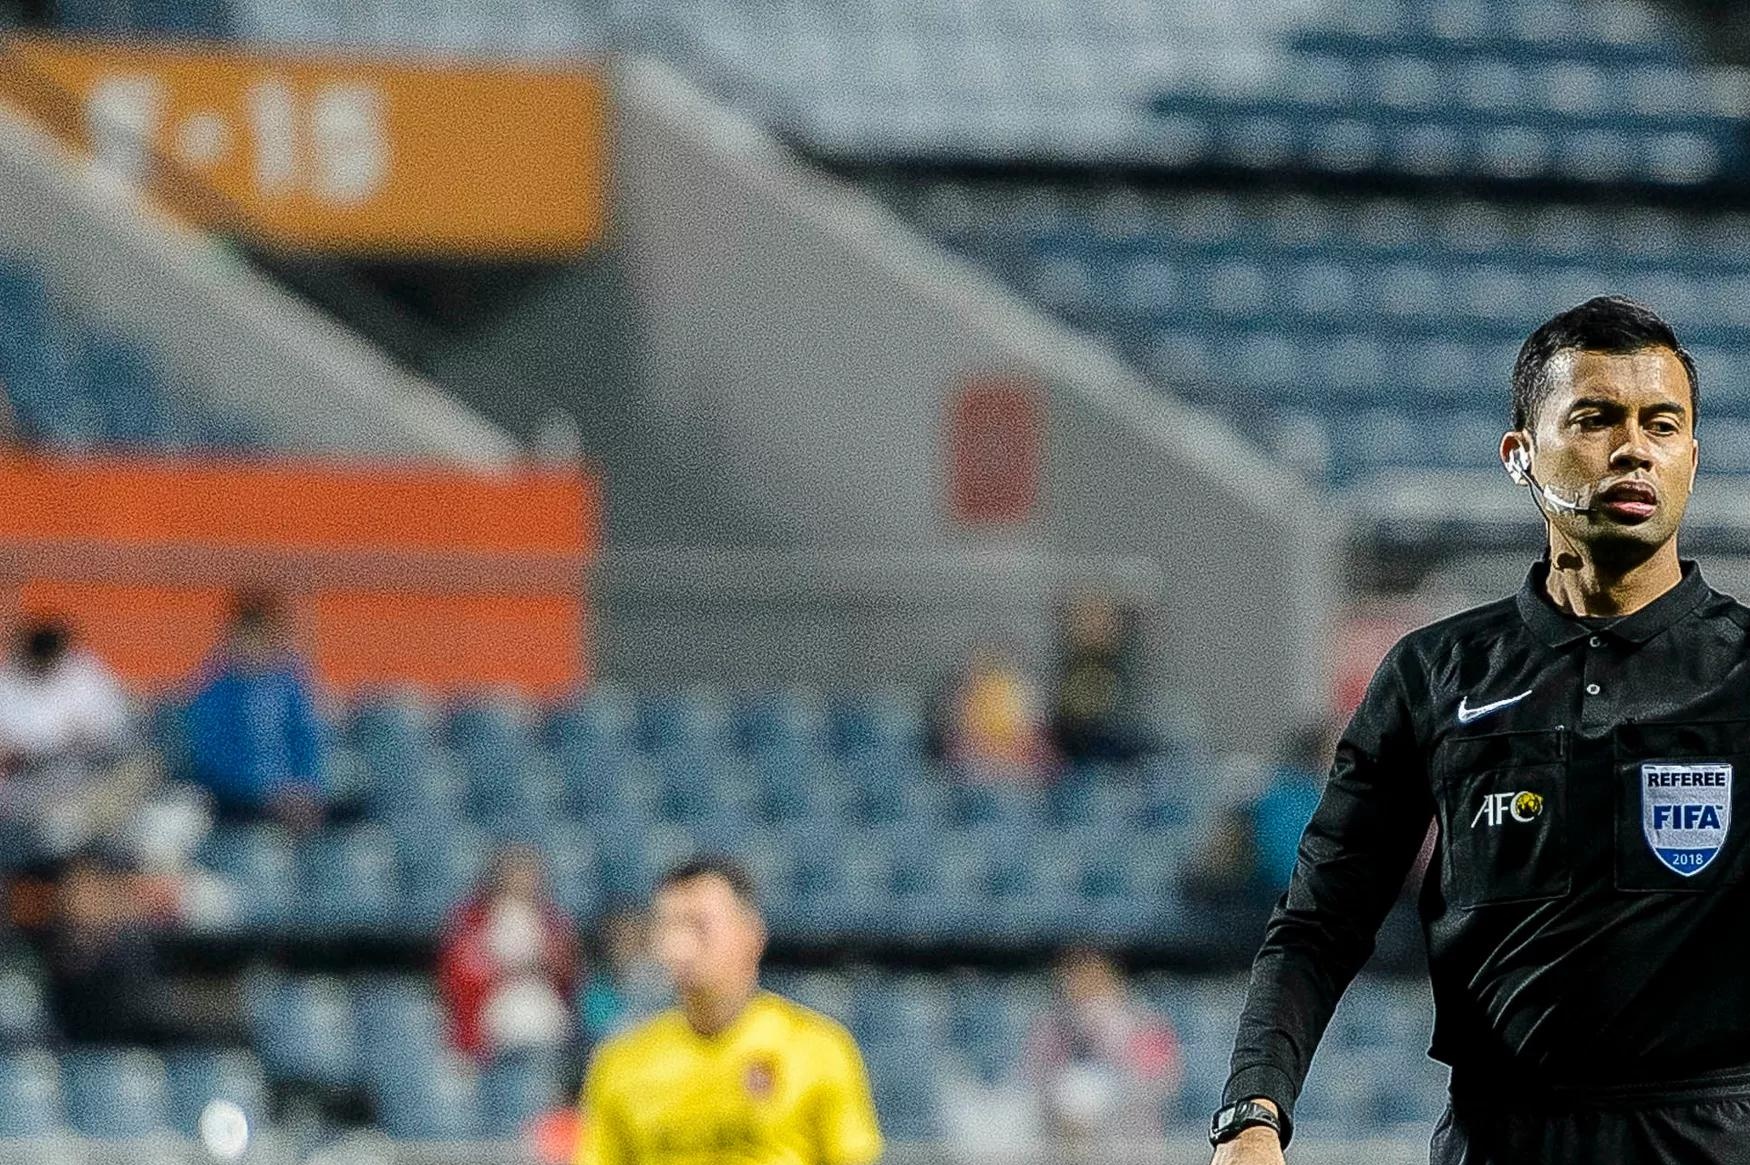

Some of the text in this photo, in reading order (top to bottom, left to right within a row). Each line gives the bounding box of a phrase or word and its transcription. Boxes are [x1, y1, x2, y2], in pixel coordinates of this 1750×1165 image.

[1647, 771, 1726, 787] REFEREE
[1471, 790, 1544, 828] AFC
[1653, 804, 1721, 830] FIFA
[1672, 853, 1704, 866] 2018
